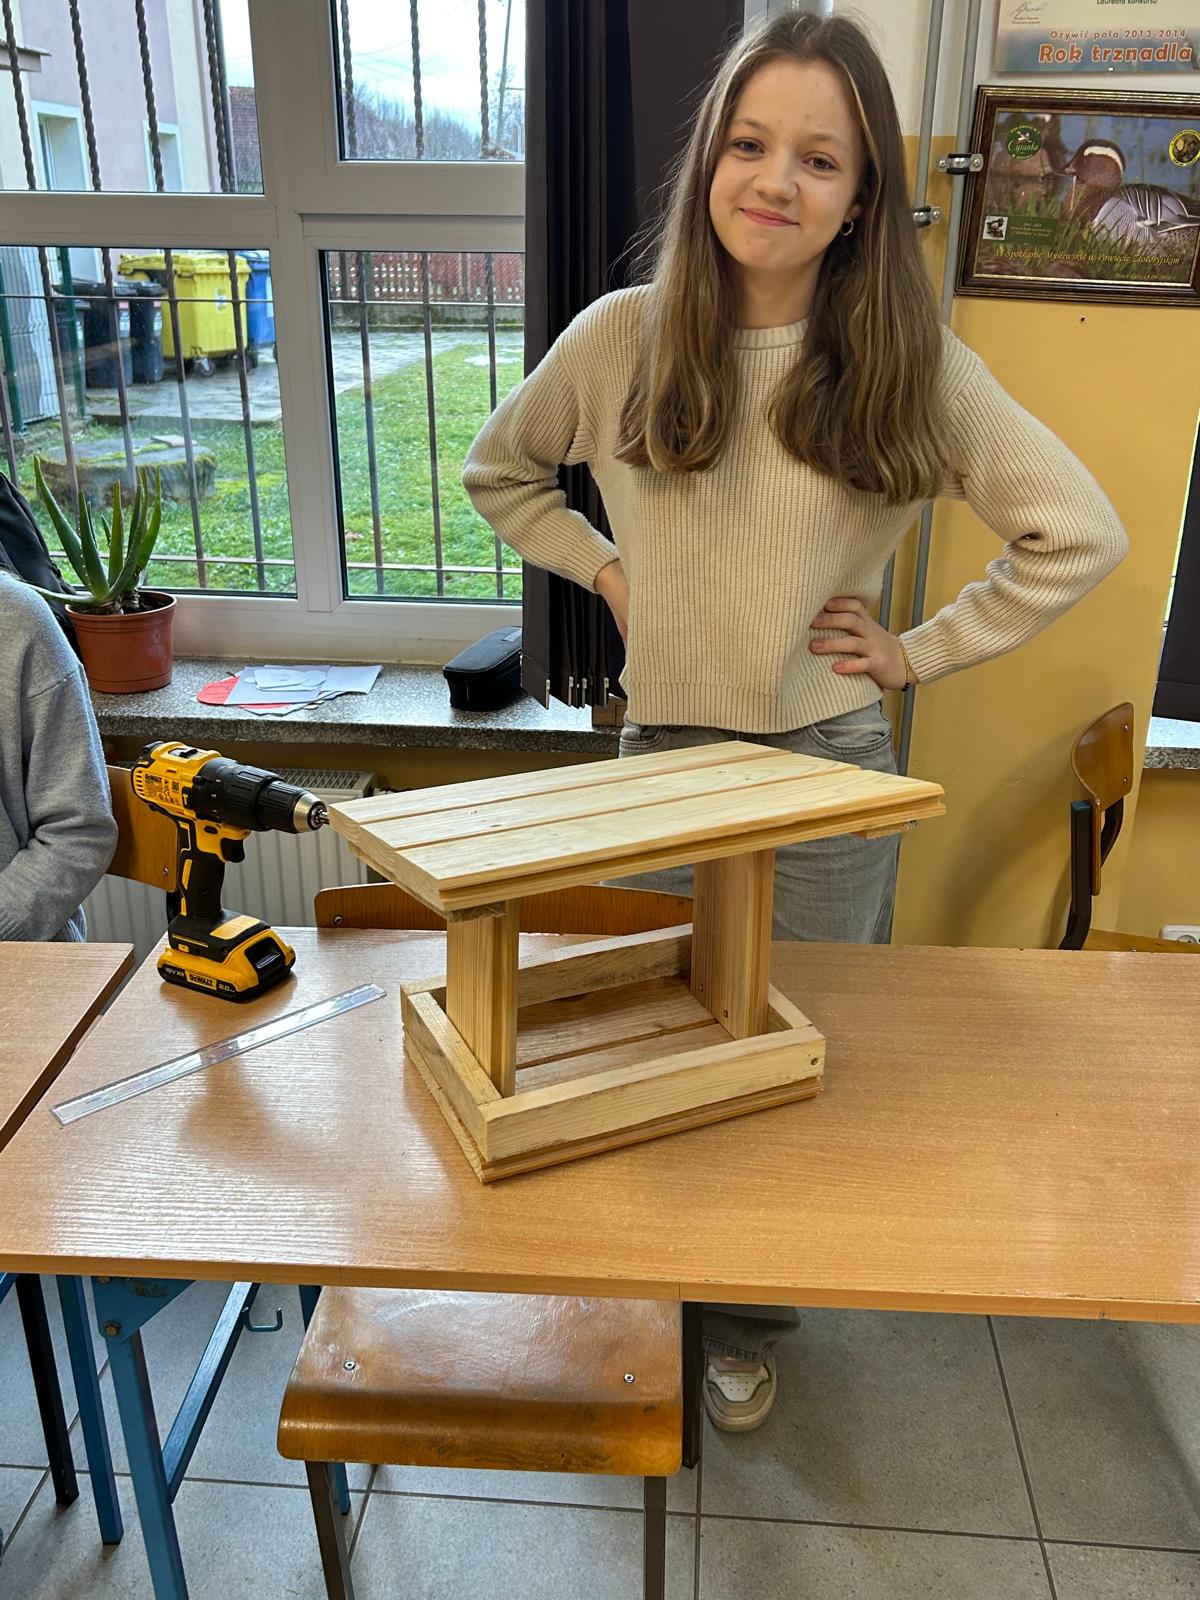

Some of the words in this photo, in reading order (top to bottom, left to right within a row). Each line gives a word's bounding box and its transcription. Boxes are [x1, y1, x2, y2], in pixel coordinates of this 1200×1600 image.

[1050, 29, 1089, 40] Ożywić
[1094, 29, 1119, 40] pola
[1125, 29, 1186, 39] 2013-2014
[1038, 43, 1083, 63] Rok
[1091, 42, 1192, 62] trznadla
